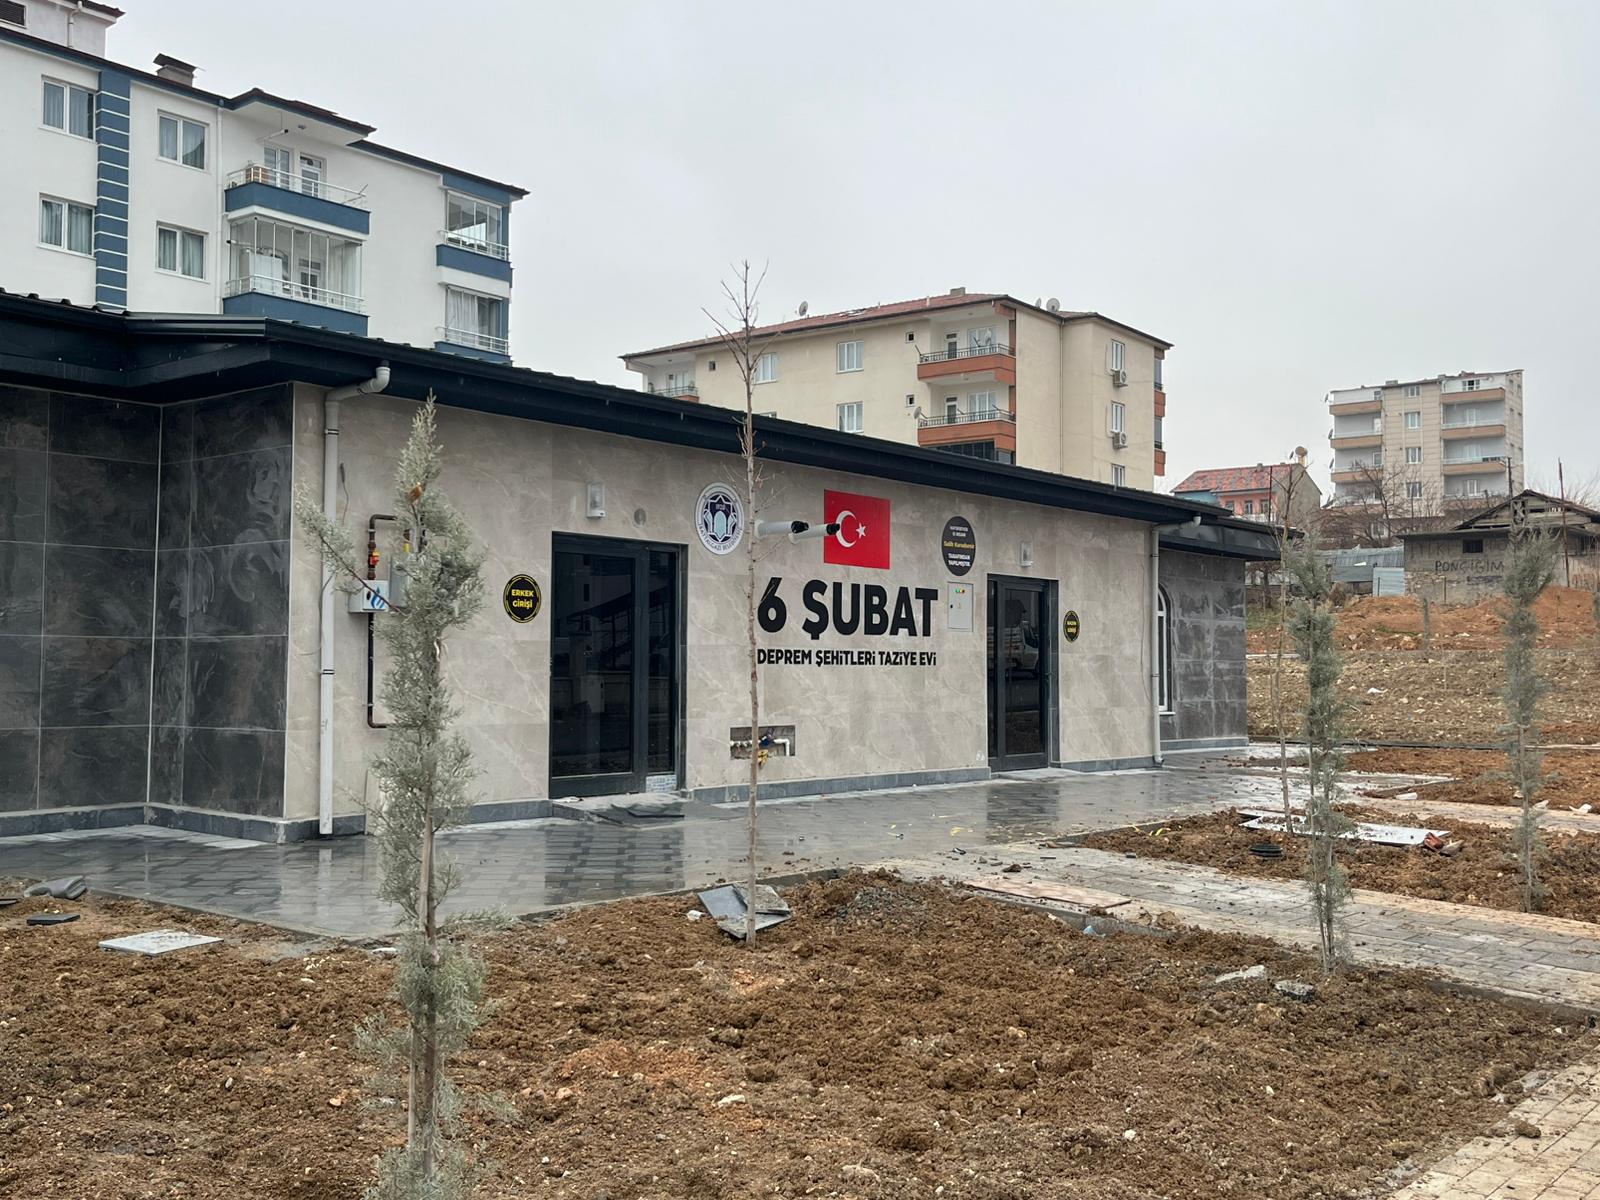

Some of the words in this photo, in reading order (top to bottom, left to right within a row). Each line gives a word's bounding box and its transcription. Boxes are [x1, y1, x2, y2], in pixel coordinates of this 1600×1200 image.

[511, 588, 534, 597] ERKEK
[757, 576, 787, 633] 6
[801, 579, 939, 641] ŞUBAT
[757, 648, 812, 665] DEPREM
